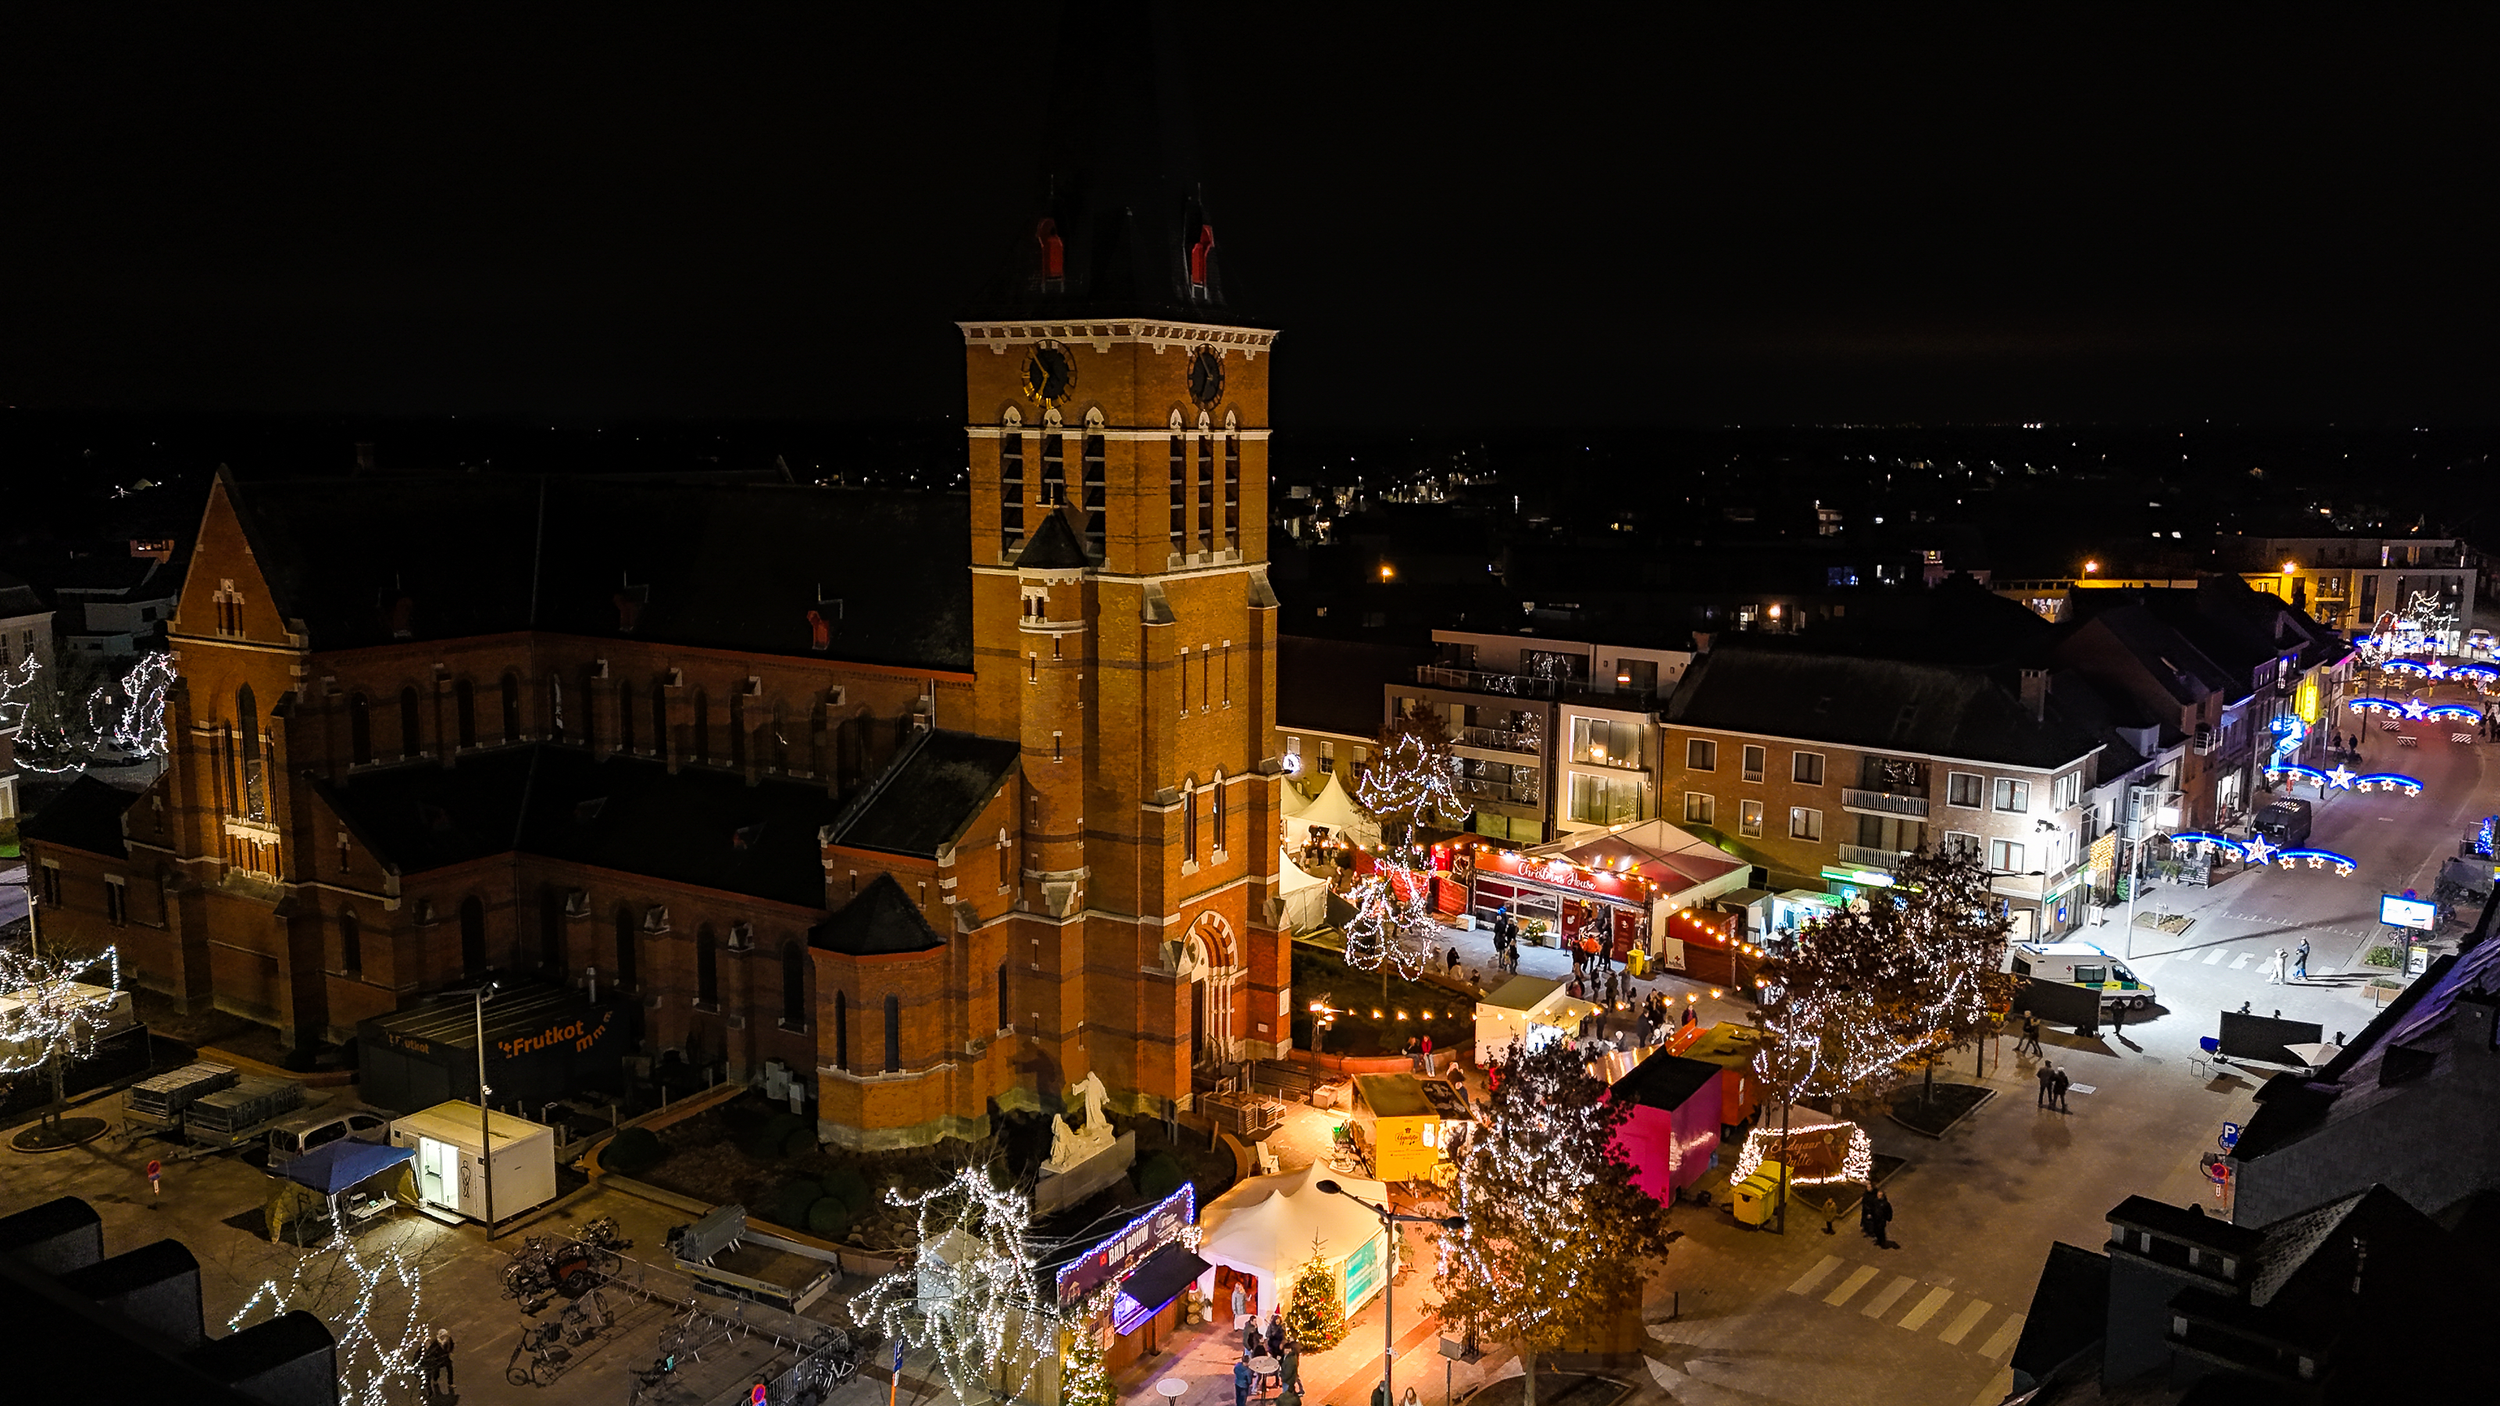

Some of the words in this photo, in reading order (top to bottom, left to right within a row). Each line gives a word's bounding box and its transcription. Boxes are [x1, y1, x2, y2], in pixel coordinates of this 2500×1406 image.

[1566, 872, 1597, 890] House
[395, 1035, 430, 1054] Futkot
[513, 1020, 584, 1056] Frutkot
[2224, 1124, 2236, 1138] P
[1108, 1241, 1125, 1267] BAR
[1126, 1223, 1149, 1255] BOUW
